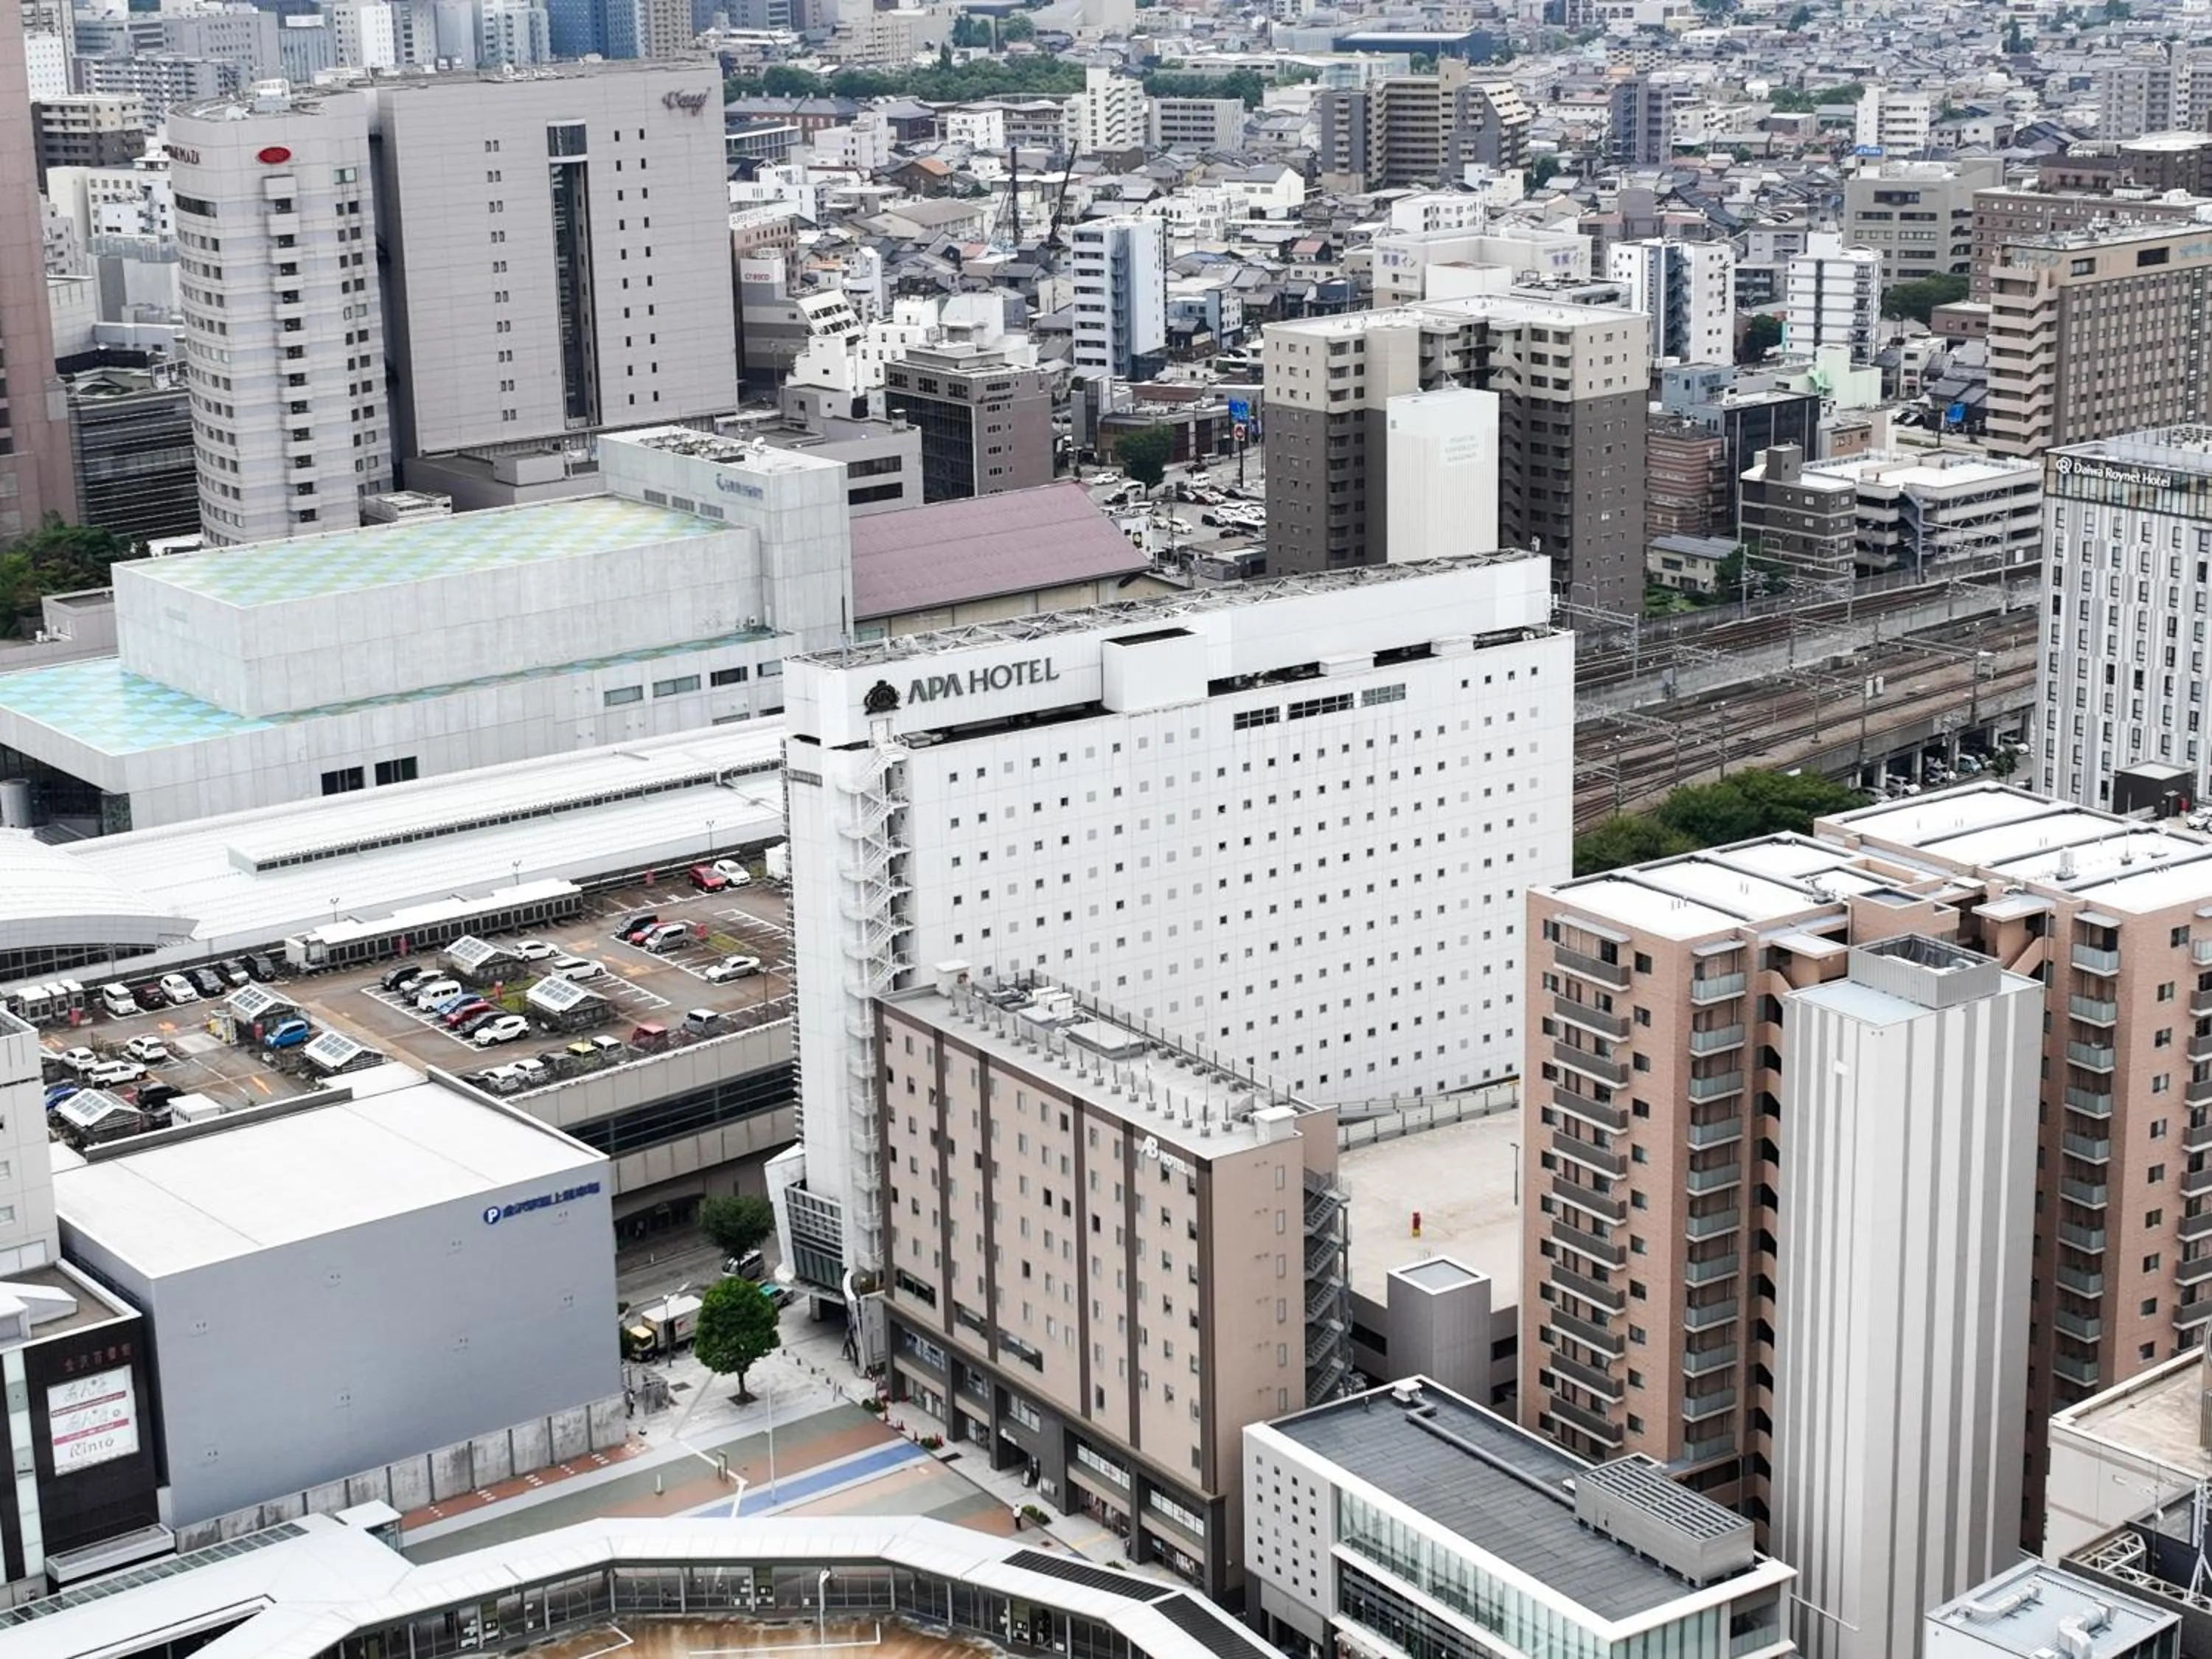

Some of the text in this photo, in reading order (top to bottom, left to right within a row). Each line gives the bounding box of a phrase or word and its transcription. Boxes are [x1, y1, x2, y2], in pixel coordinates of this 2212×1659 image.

[2073, 462, 2171, 487] Daiwa Roynet Hotel
[908, 657, 1060, 704] APA HOTEL
[486, 1207, 499, 1224] P
